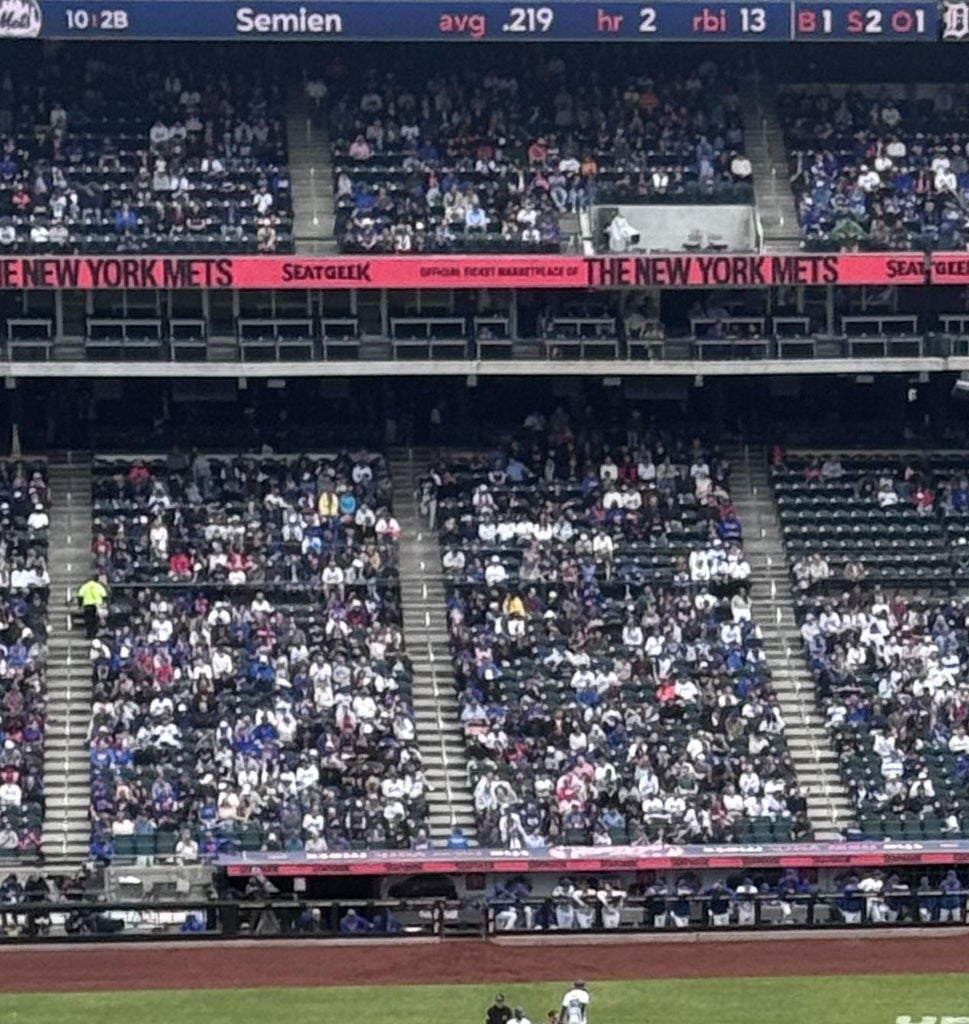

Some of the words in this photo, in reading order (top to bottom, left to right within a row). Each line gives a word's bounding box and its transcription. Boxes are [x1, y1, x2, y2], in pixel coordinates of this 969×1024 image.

[66, 10, 88, 28] 10
[101, 10, 129, 29] 2B
[236, 7, 342, 32] Semien
[439, 12, 486, 39] avg
[502, 8, 553, 32] .219
[597, 9, 624, 32] hr
[639, 8, 657, 32] 2
[693, 9, 727, 32] rbi
[740, 8, 767, 32] 13
[22, 259, 80, 287] NEW
[86, 259, 158, 287] YORK
[163, 259, 233, 287] METS
[282, 262, 371, 282] SEATGEEK
[583, 258, 631, 286] THE
[634, 257, 690, 285] NEW
[695, 256, 766, 285] YORK
[772, 256, 838, 285] METS
